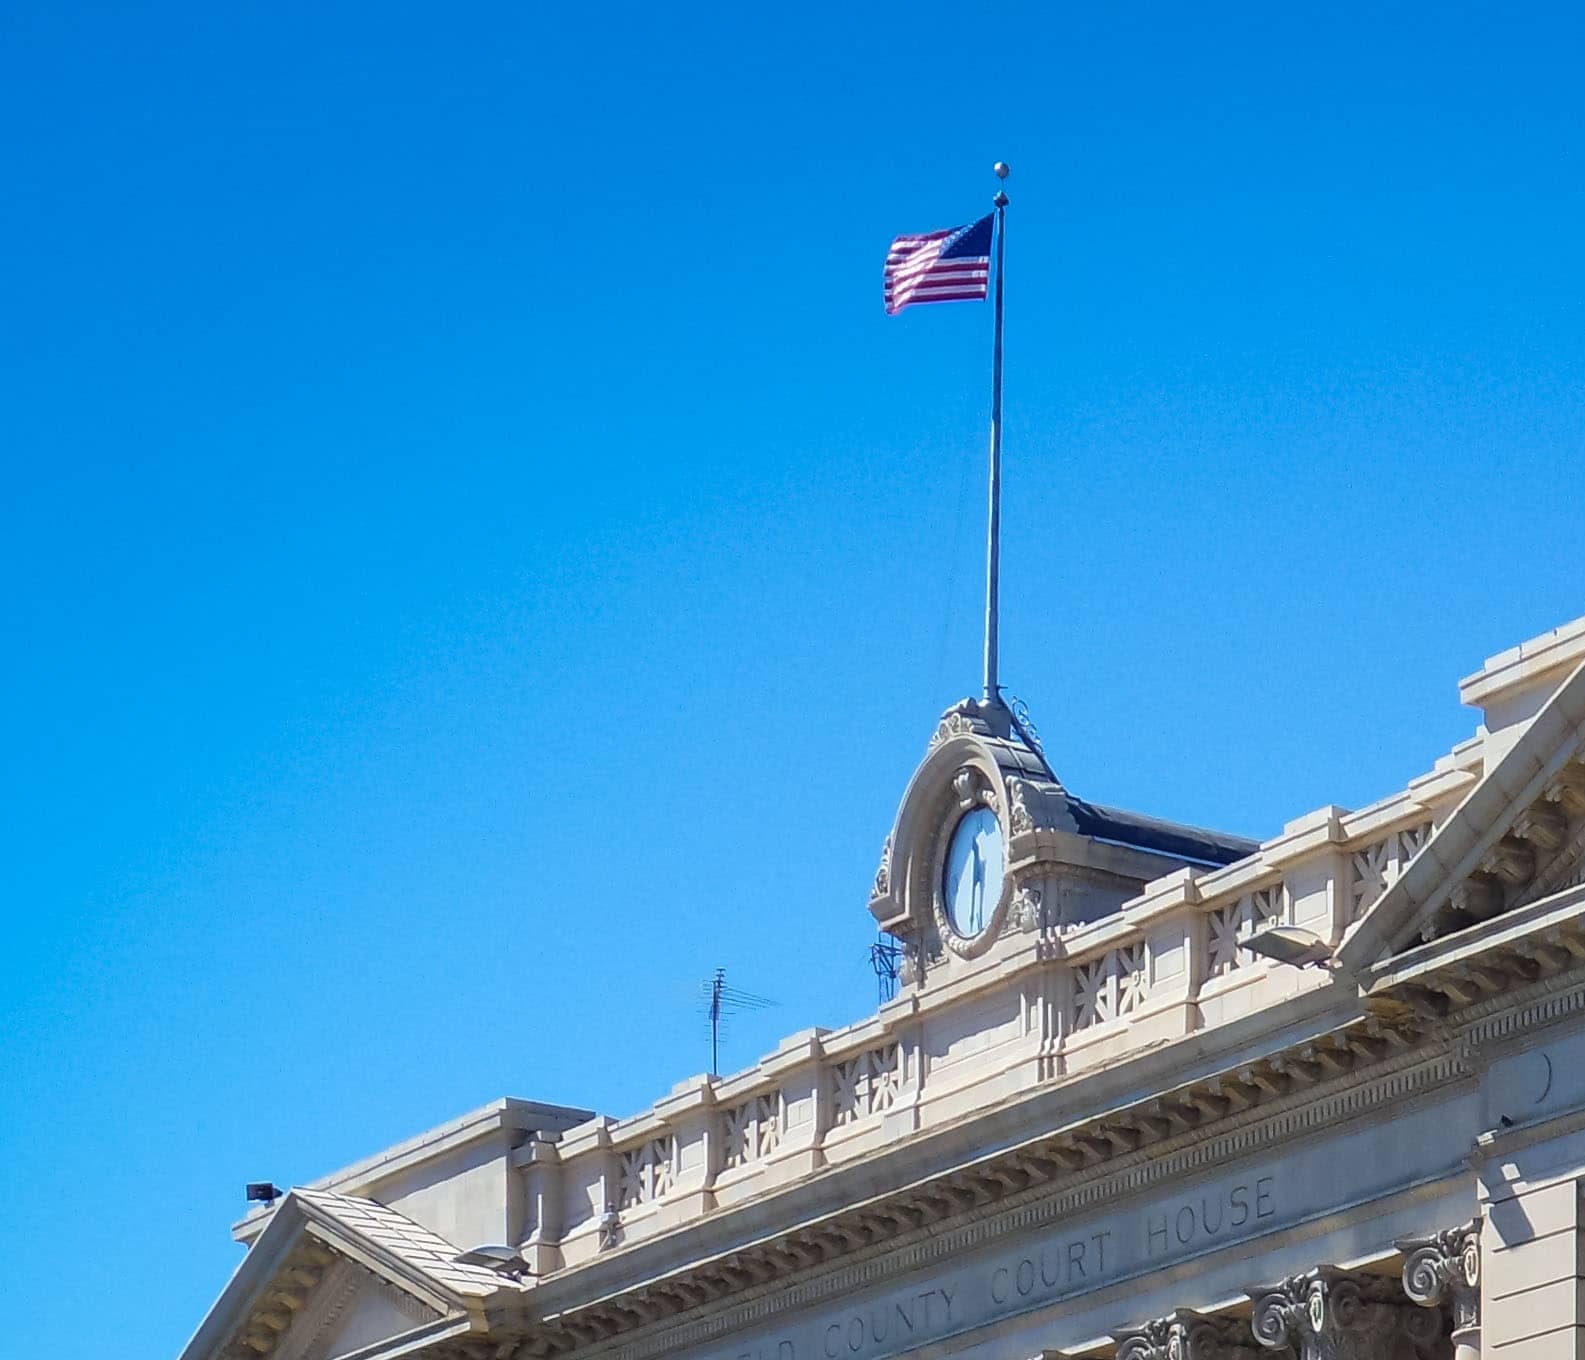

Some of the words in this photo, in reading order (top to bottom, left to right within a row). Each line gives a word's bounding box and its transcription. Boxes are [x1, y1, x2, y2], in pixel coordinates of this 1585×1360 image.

[824, 1287, 957, 1359] COUNTY
[991, 1230, 1111, 1304] COURT
[1146, 1176, 1276, 1256] HOUSE
